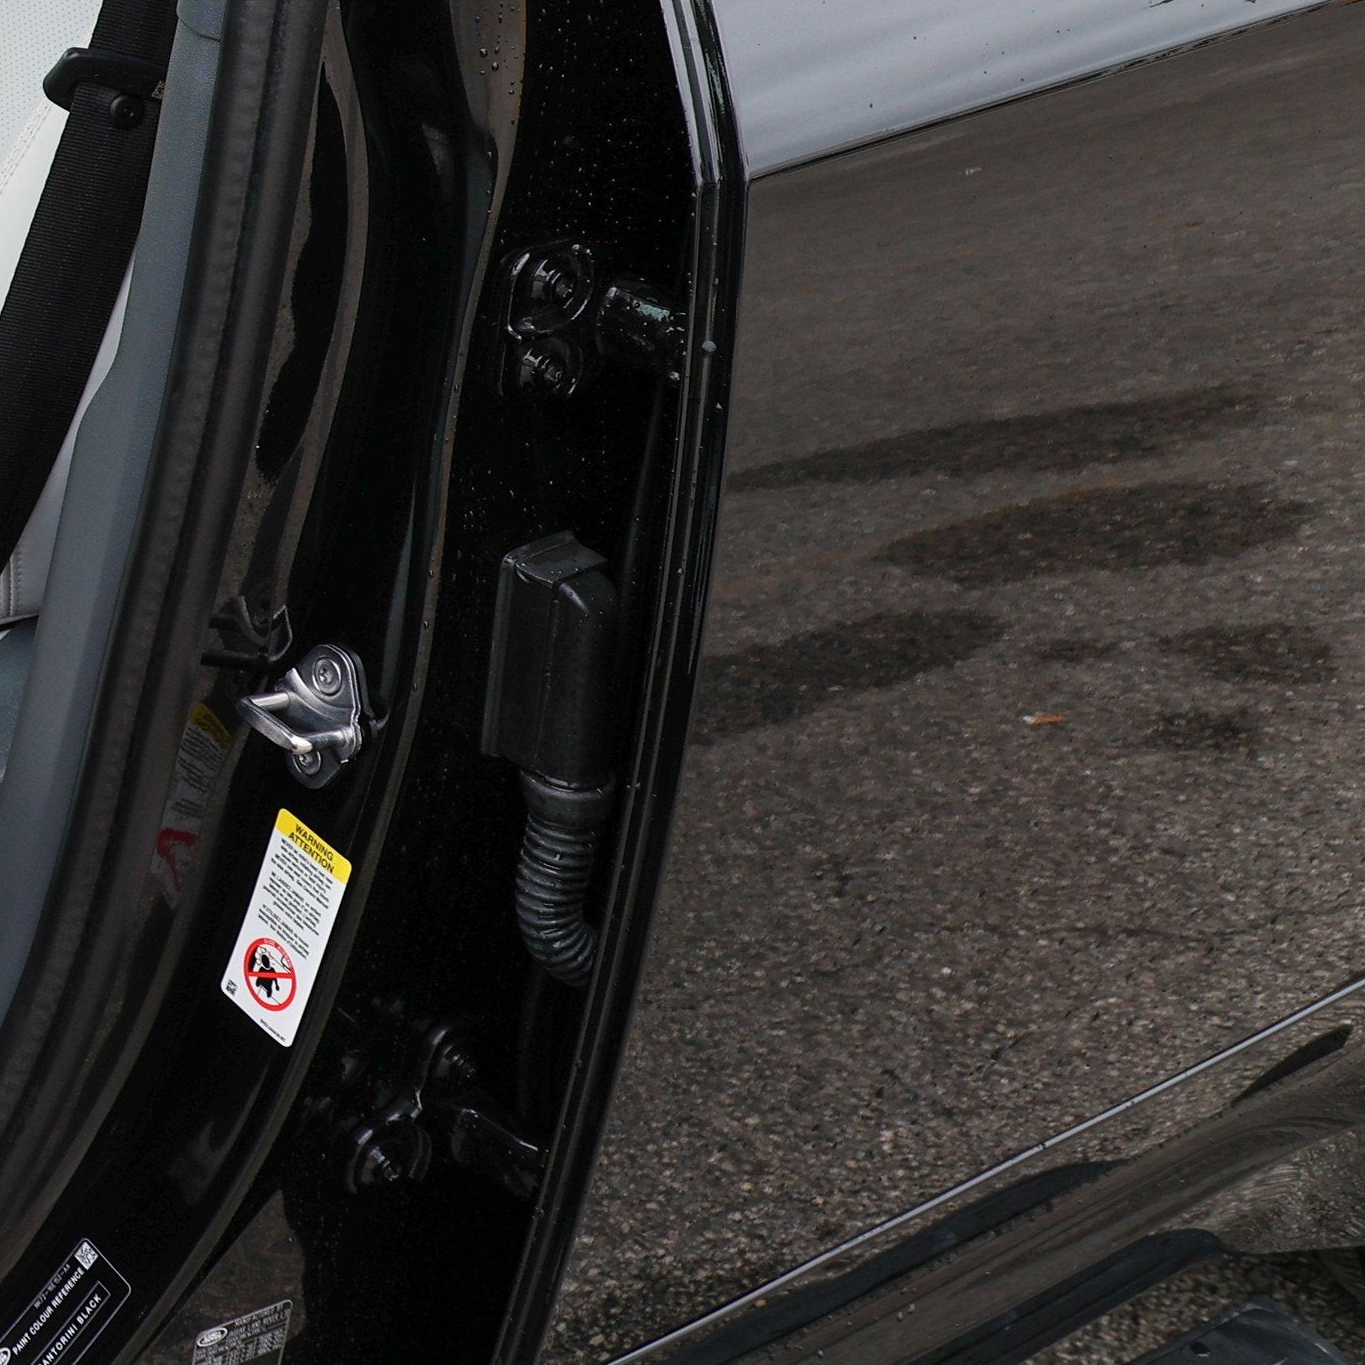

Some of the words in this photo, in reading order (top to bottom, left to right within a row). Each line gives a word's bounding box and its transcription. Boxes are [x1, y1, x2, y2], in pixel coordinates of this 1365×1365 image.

[288, 831, 335, 874] ATTENTION
[295, 824, 334, 861] WARNING
[12, 1333, 32, 1356] PAINT
[29, 1306, 54, 1336] COLOUR
[51, 1267, 85, 1308] REFERENCE
[38, 1324, 78, 1365] ANTORINI
[76, 1293, 102, 1325] BLACK
